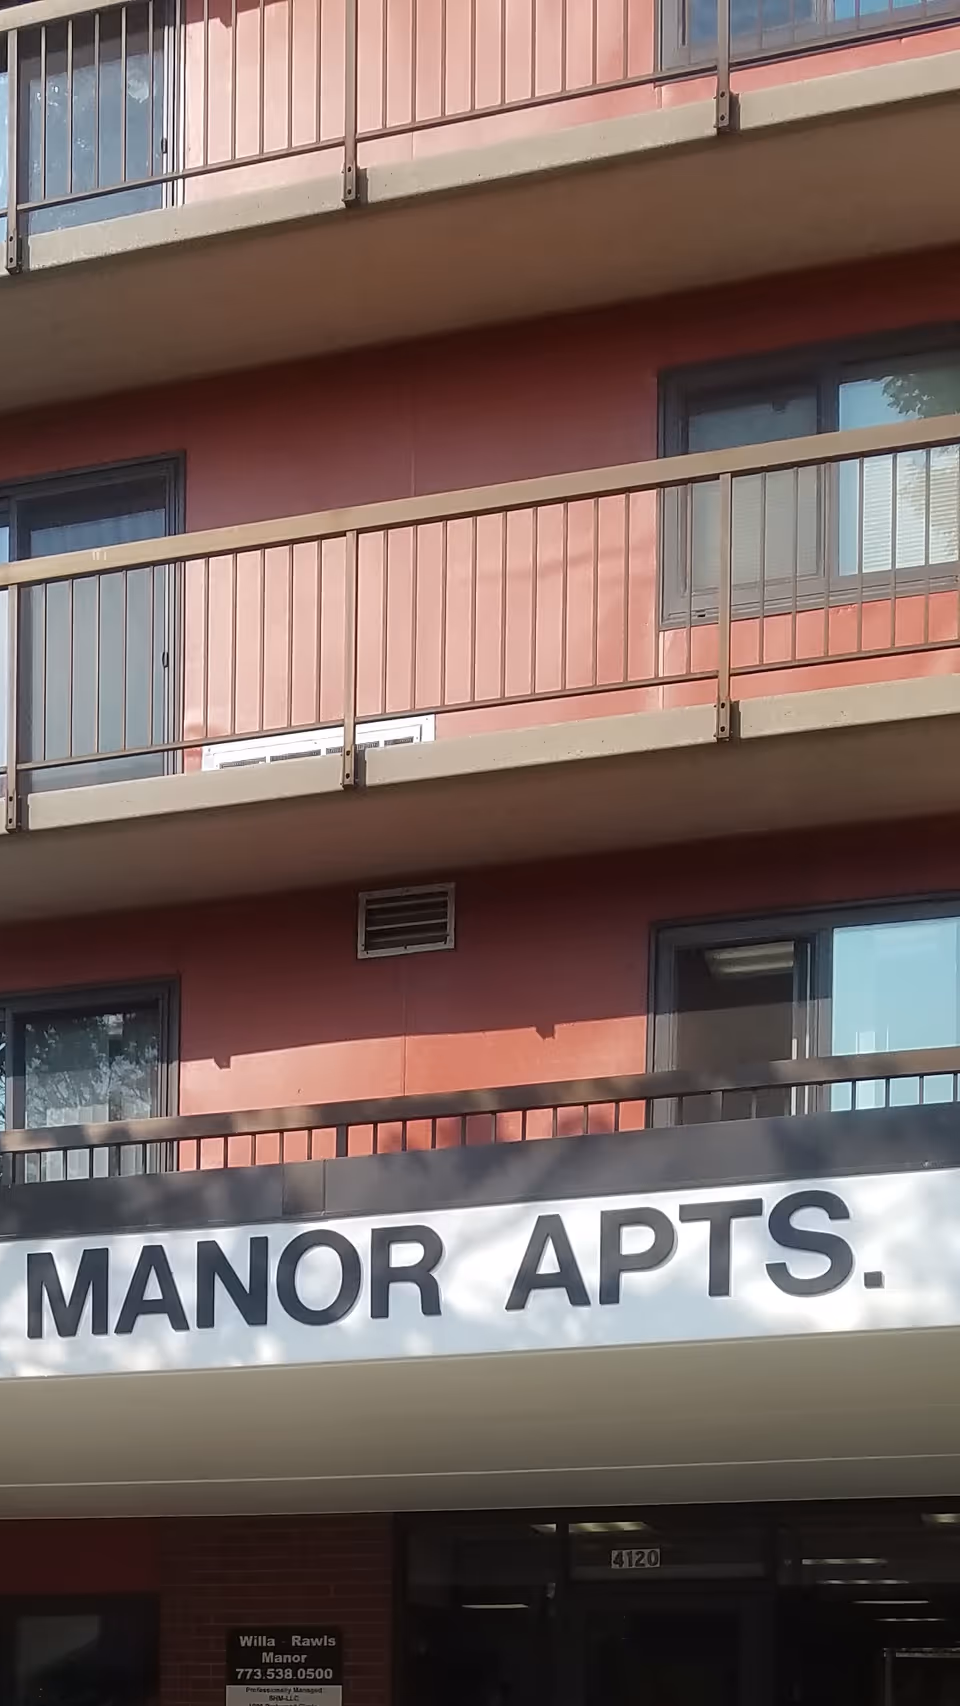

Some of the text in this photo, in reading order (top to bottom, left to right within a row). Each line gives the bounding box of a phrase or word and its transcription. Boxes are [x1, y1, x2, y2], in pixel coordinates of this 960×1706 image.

[26, 1224, 442, 1340] MANOR
[505, 1190, 885, 1312] APTS.
[613, 1549, 659, 1567] 4120
[239, 1635, 276, 1647] Willa
[291, 1635, 336, 1647] Rawls
[261, 1651, 308, 1663] Manor
[235, 1668, 333, 1680] 773.538.0500
